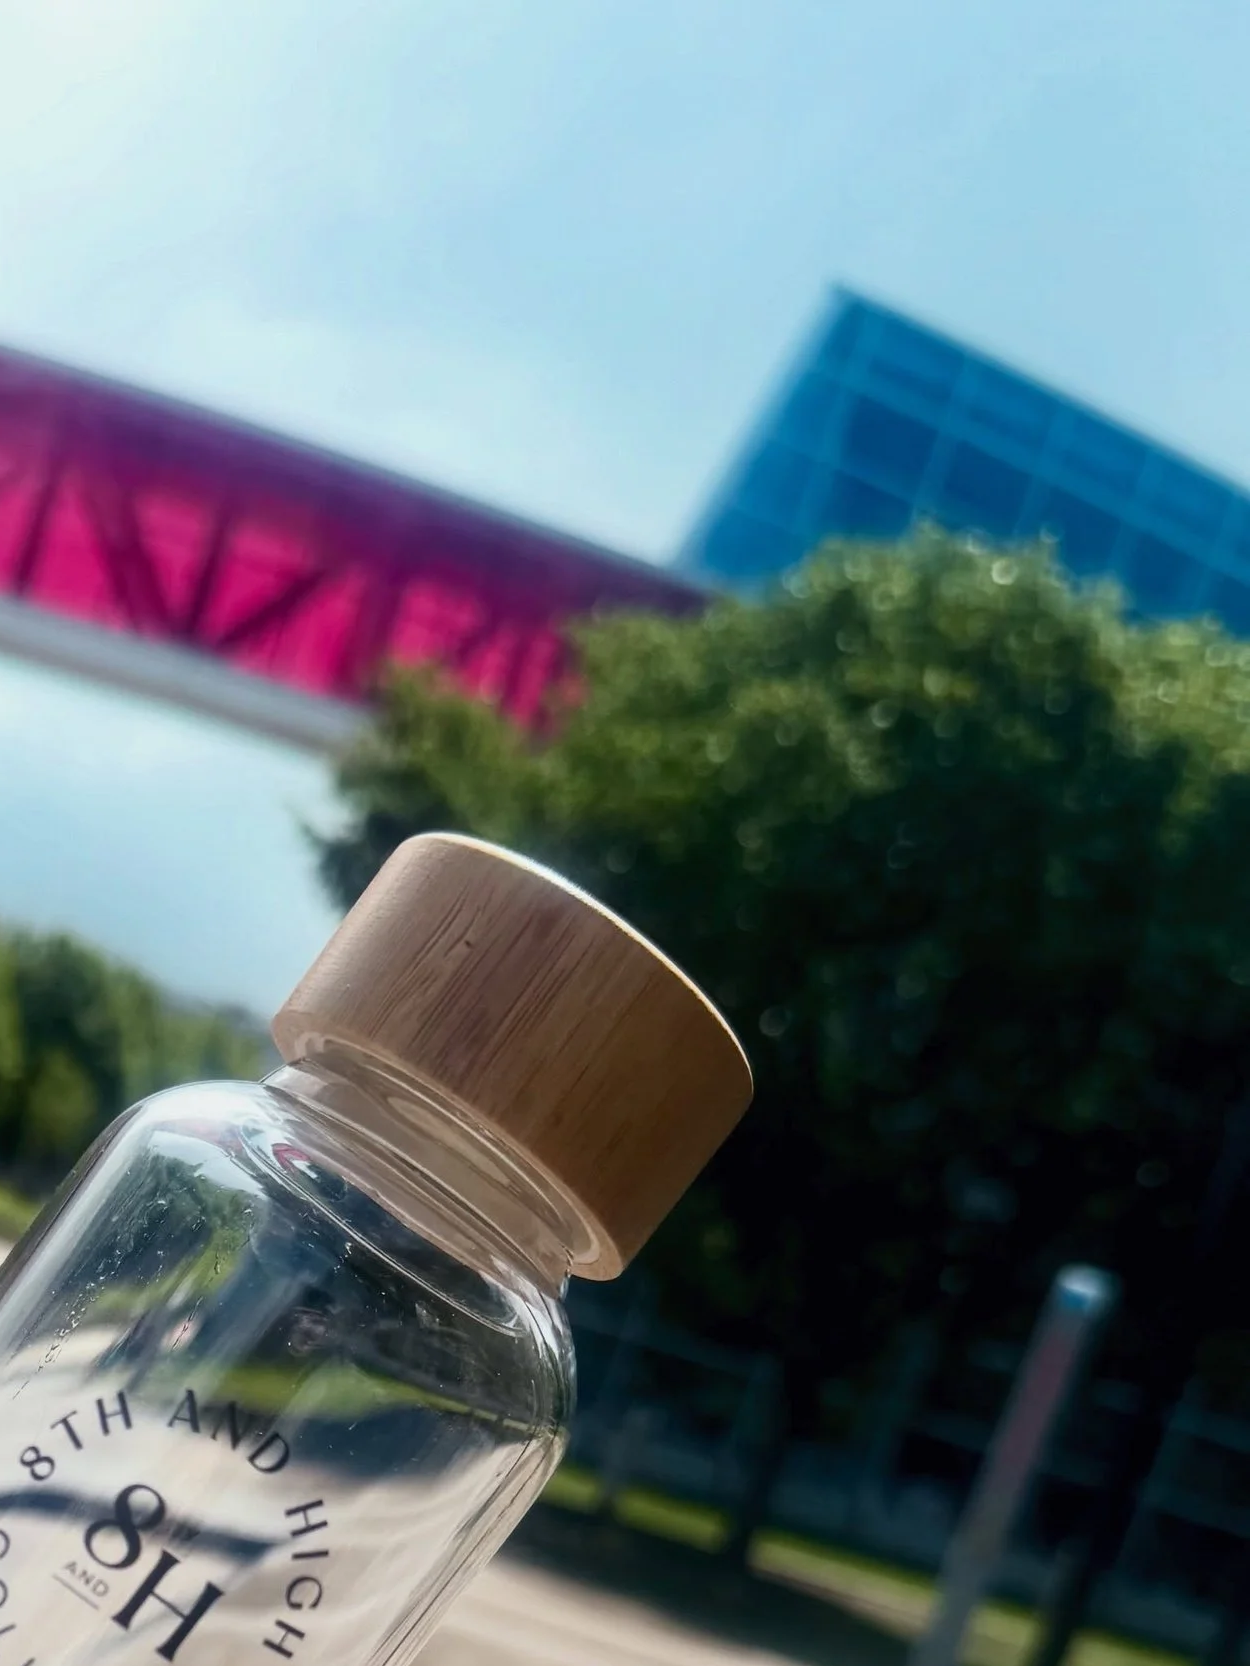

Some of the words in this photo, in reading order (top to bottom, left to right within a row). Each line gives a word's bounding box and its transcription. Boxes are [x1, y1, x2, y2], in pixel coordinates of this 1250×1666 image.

[19, 1391, 133, 1481] 8TH
[167, 1389, 290, 1473] AND
[262, 1499, 329, 1658] HIGH
[83, 1484, 166, 1569] 8
[64, 1561, 110, 1597] AND
[111, 1549, 225, 1662] H
